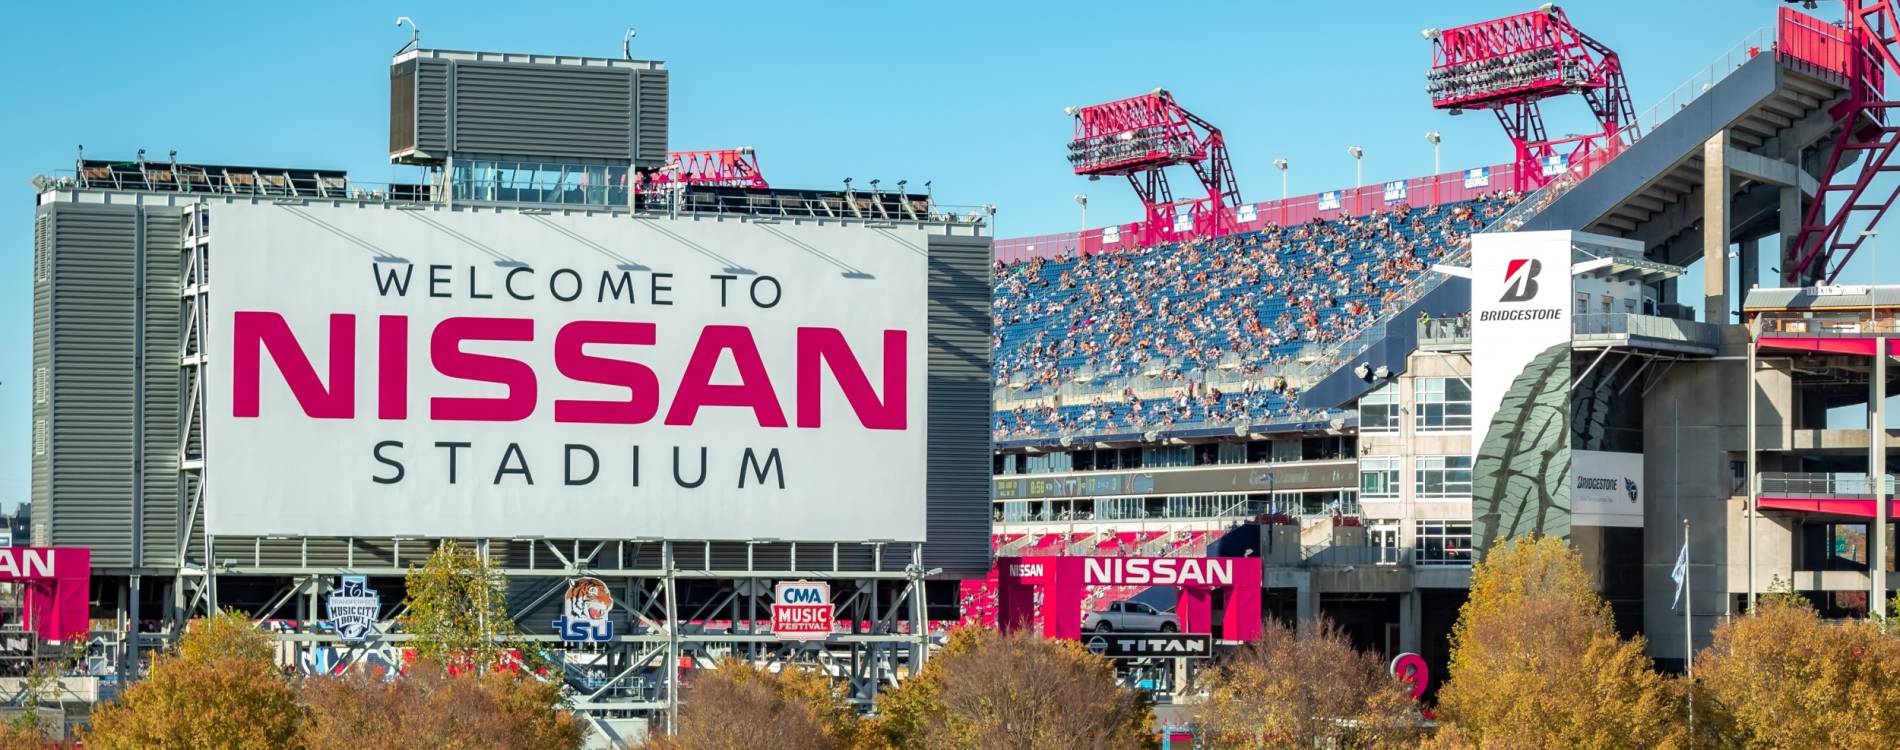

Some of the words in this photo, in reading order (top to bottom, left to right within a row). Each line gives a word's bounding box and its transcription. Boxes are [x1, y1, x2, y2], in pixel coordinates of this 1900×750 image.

[372, 262, 674, 307] WELCOME
[710, 275, 782, 309] TO
[1480, 309, 1562, 321] BRIDGESTONE
[233, 311, 908, 430] NISSAN
[372, 440, 787, 490] STADIUM
[1577, 476, 1618, 490] BRIDGESTONE
[1009, 564, 1044, 577] NISSAN
[1084, 558, 1233, 584] NISSAN
[783, 588, 822, 604] CMA
[330, 605, 357, 619] MUSIC
[357, 605, 378, 619] CITY
[778, 608, 827, 623] MUSIC
[341, 615, 366, 625] BOWL
[778, 622, 828, 630] FESTIVAL
[1117, 639, 1204, 652] TITAN
